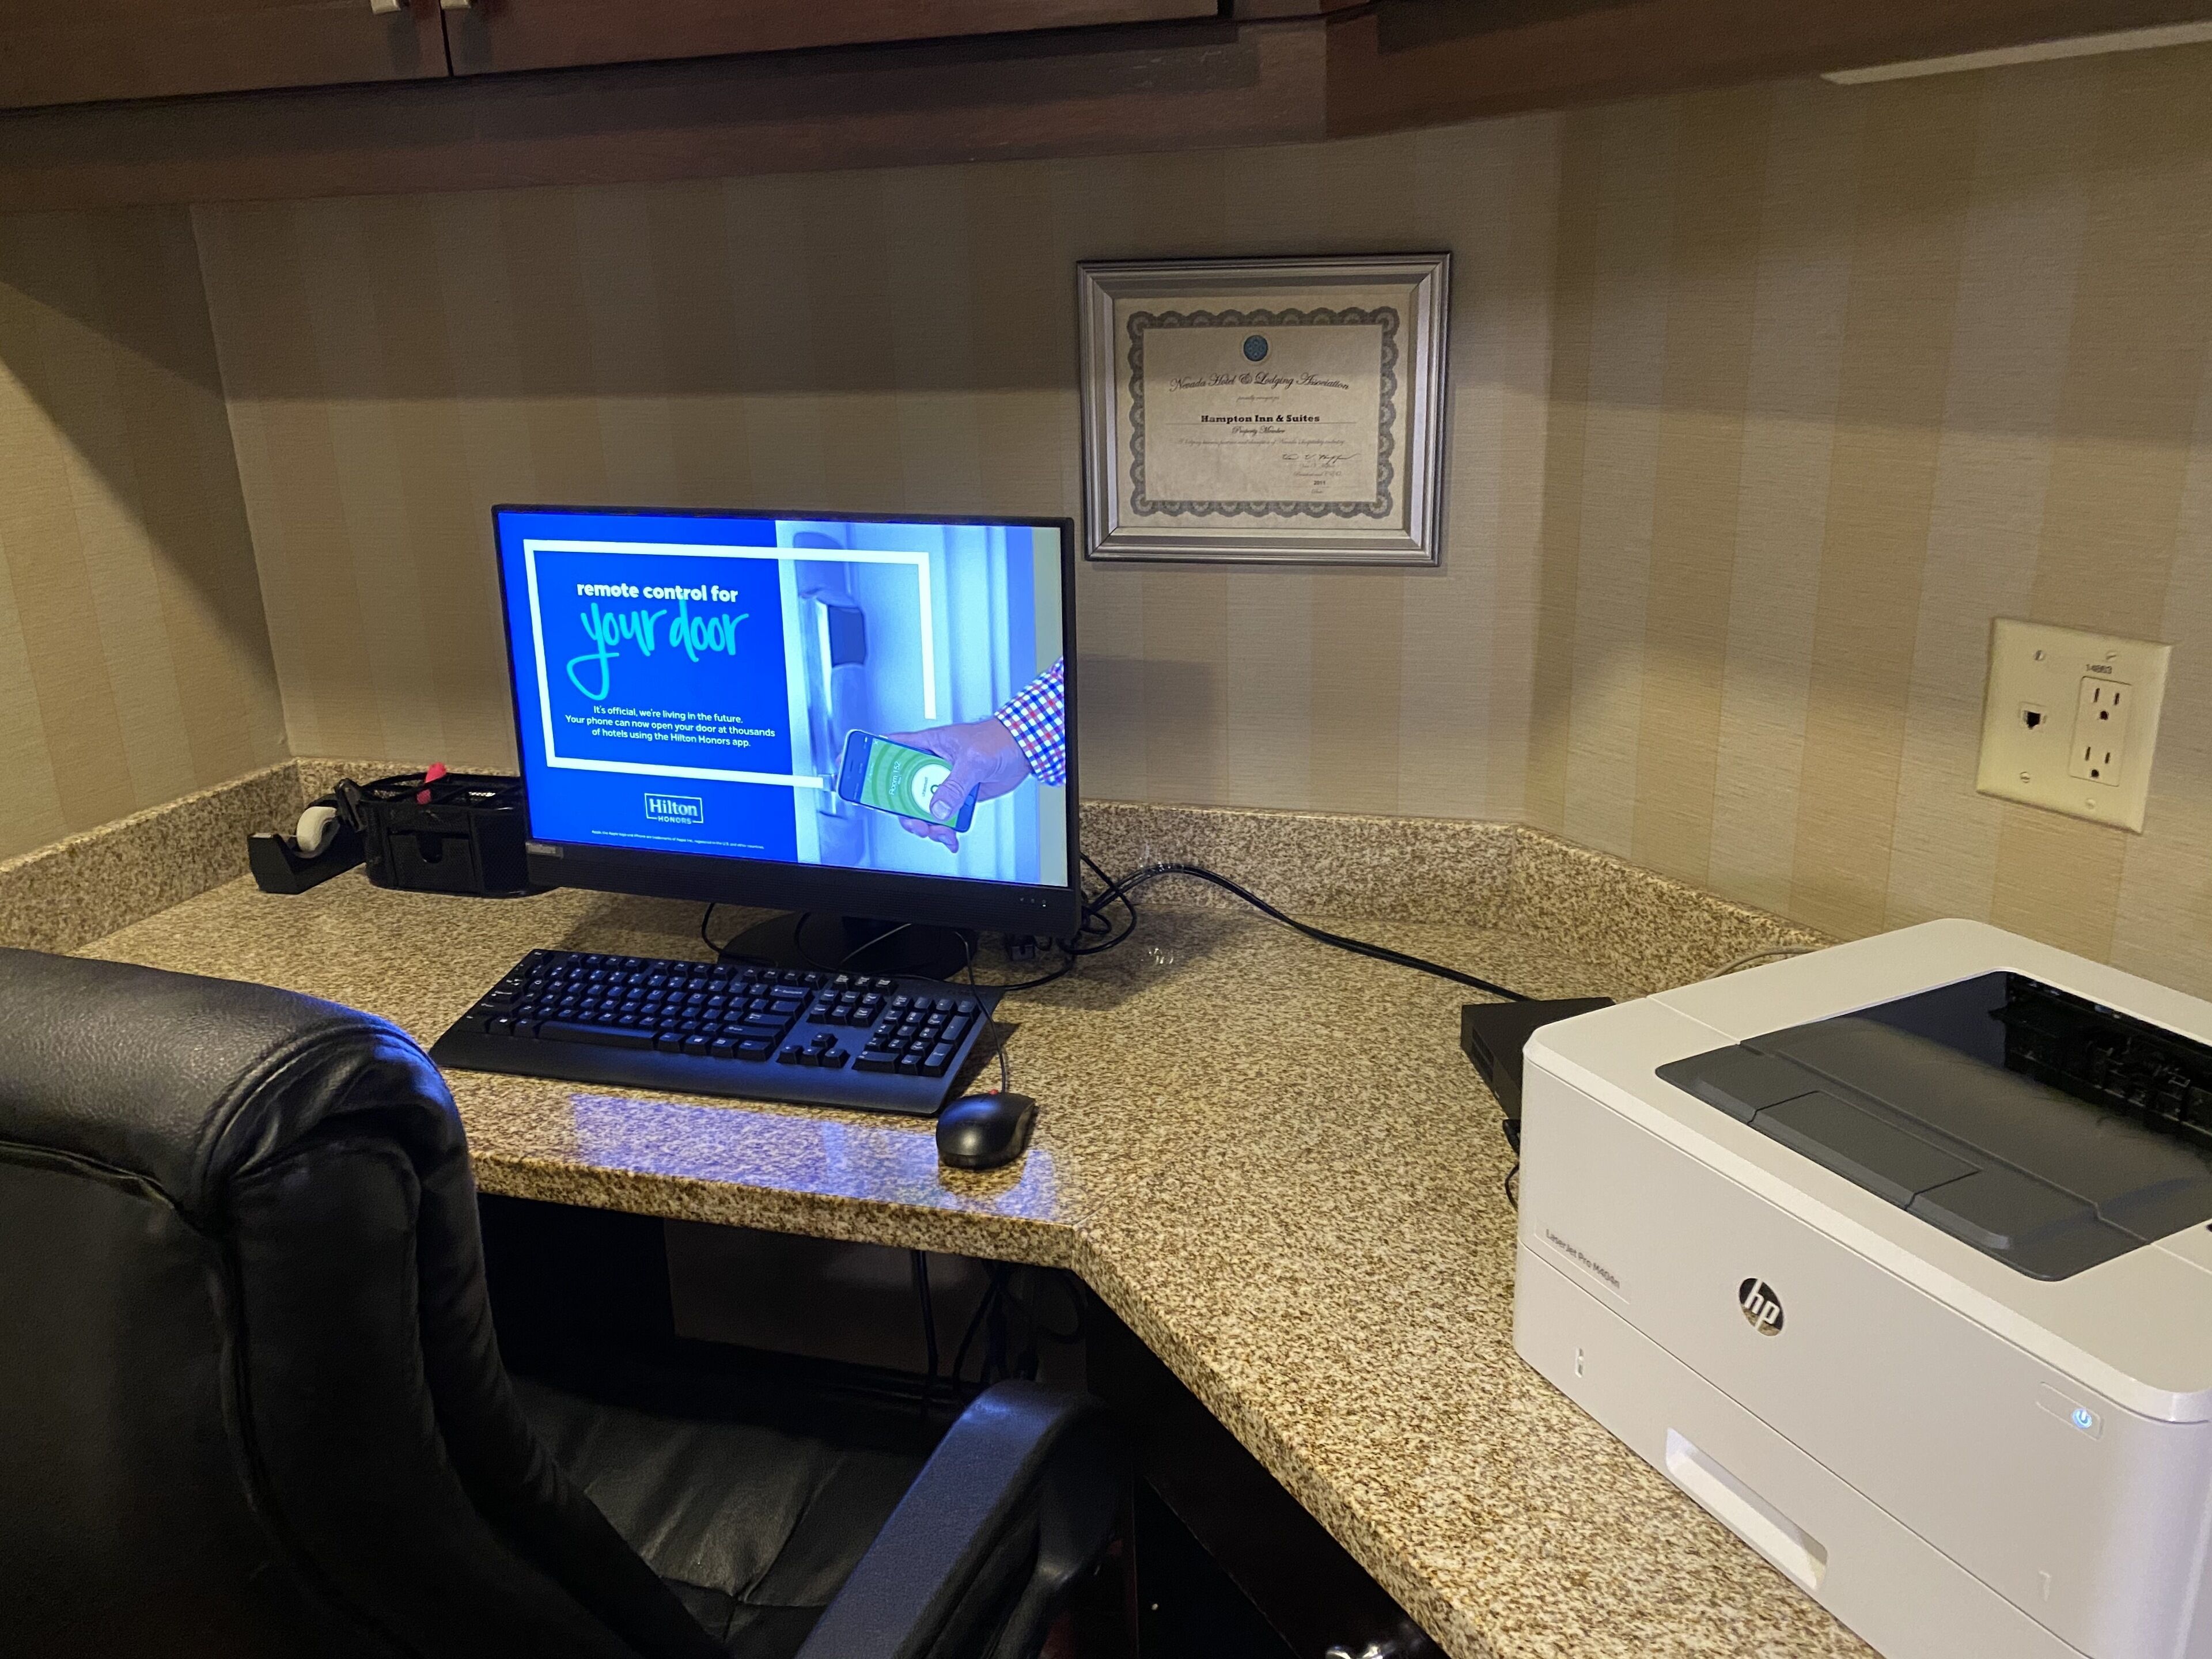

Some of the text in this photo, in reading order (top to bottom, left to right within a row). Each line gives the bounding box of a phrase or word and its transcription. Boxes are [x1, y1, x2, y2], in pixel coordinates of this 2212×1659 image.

[1208, 373, 1237, 387] Hotel
[1254, 372, 1294, 389] Lodging
[1296, 372, 1350, 389] Association
[1201, 414, 1320, 424] Hampton Inn & Suites
[577, 582, 738, 602] remote control for
[567, 599, 749, 700] your door
[593, 706, 743, 724] It's official, we're living in the future.
[565, 714, 585, 724] Your
[586, 717, 613, 727] phone
[651, 722, 673, 732] open
[674, 724, 694, 733] your
[695, 724, 717, 733] door
[728, 726, 775, 737] thousands
[592, 728, 751, 748] of hotels using the Hilton Honors app.
[649, 798, 698, 817] Hilton
[657, 816, 692, 824] HONORS
[1577, 1251, 1593, 1268] Pro
[1741, 1277, 1782, 1333] hp
